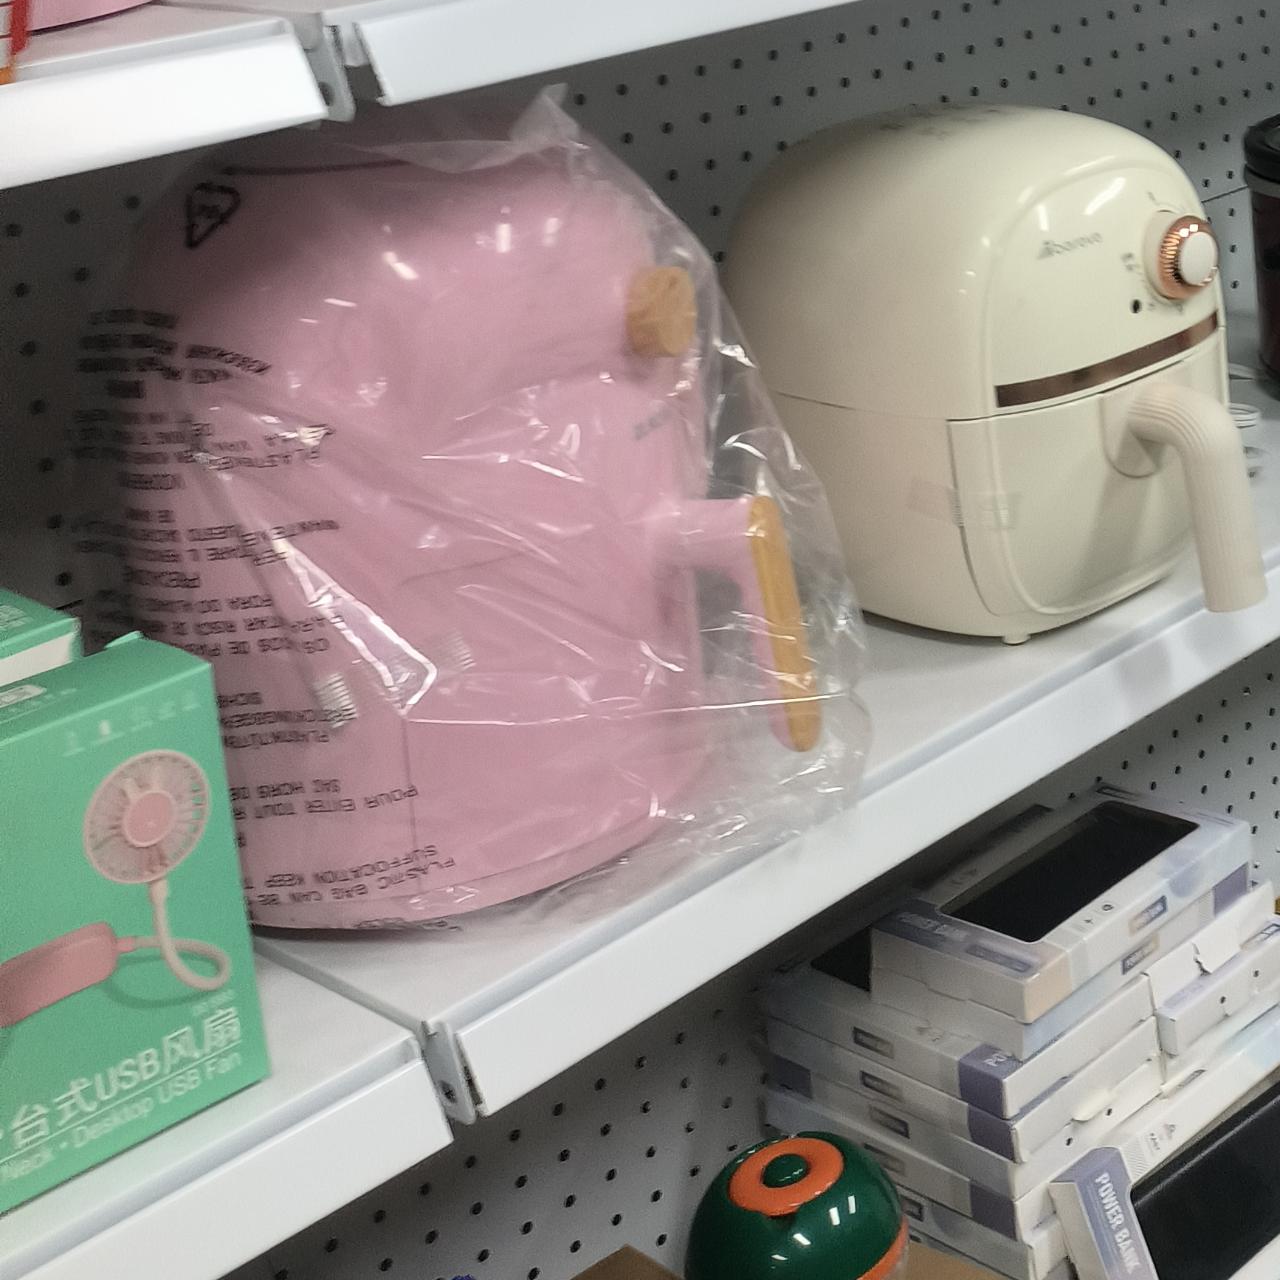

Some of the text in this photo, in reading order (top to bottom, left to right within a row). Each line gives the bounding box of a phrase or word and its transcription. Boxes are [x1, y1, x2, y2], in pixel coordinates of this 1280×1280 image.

[257, 780, 306, 800] HORS
[312, 843, 440, 885] SUFFOCATION
[376, 856, 457, 892] PLASTIC
[329, 883, 370, 902] BAG
[158, 1069, 202, 1104] USB
[205, 1051, 242, 1080] Fan
[1095, 1172, 1141, 1275] POWER BANK
